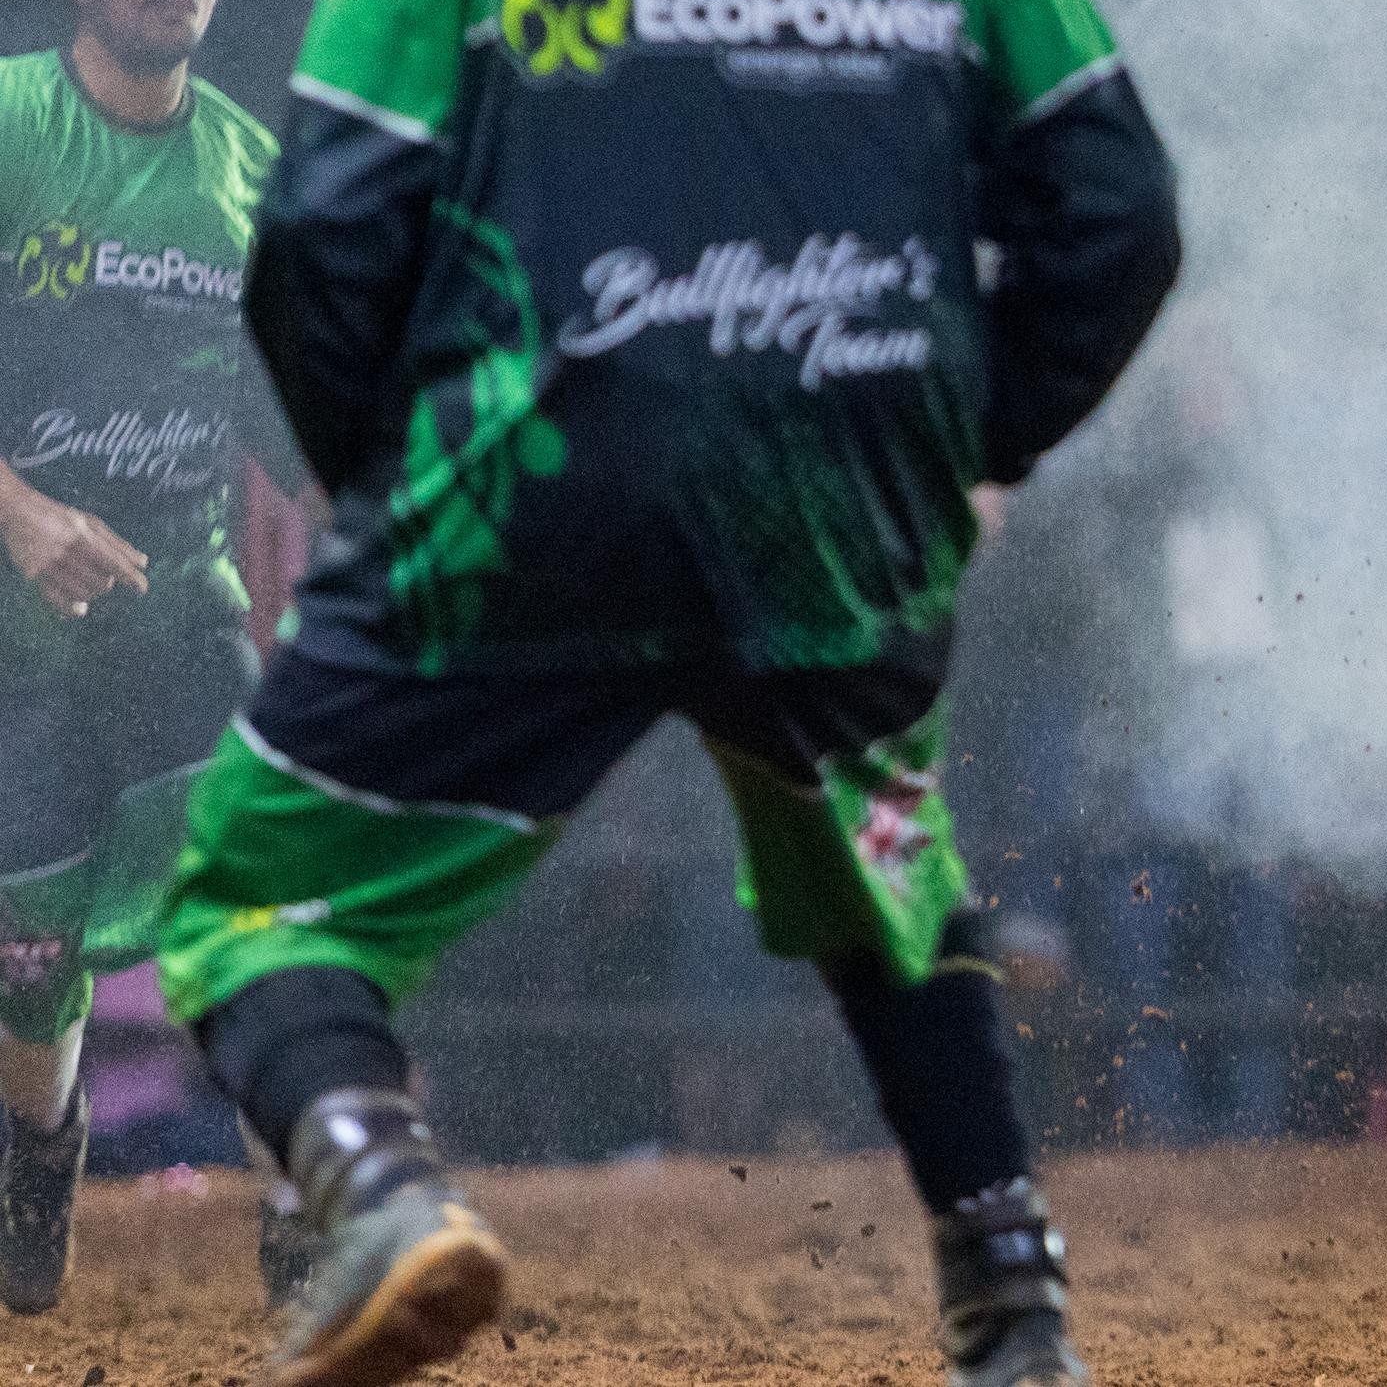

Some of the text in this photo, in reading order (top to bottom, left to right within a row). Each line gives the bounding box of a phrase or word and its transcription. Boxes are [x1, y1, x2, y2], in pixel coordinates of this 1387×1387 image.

[94, 240, 244, 303] EcoPowe
[557, 230, 941, 358] Bullfighter's
[779, 305, 934, 392] Team
[11, 407, 232, 480] Bullfighter's
